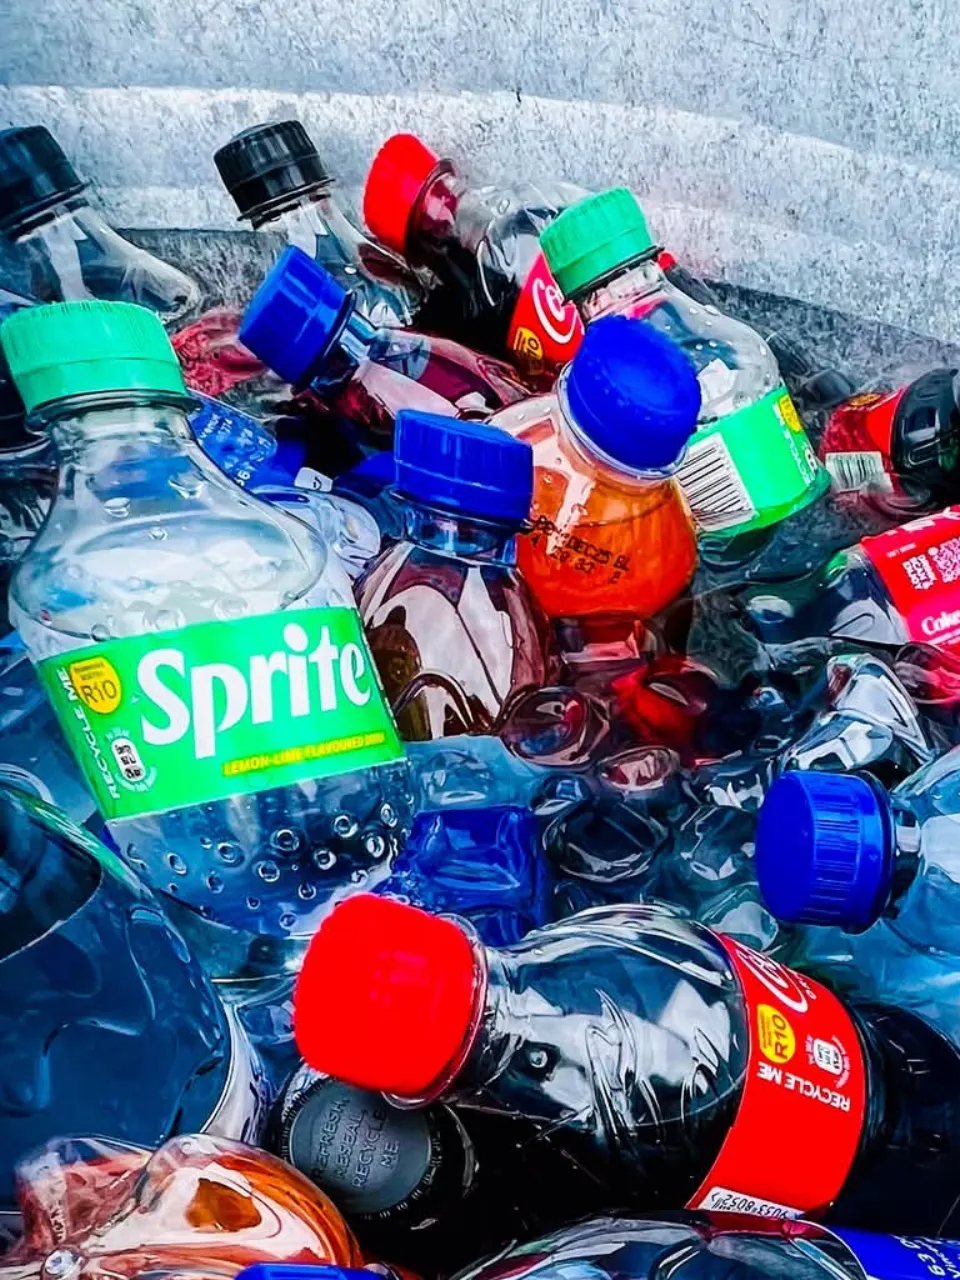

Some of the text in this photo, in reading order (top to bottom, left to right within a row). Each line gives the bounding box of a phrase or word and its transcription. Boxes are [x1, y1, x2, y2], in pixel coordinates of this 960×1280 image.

[56, 666, 79, 702] ME
[80, 679, 119, 705] R10
[137, 622, 371, 759] Sprite
[73, 704, 121, 800] RECYCLE
[771, 1013, 790, 1061] R10
[756, 1061, 851, 1112] RECYCLE ME
[334, 1108, 369, 1181] RESEAL
[352, 1108, 388, 1190] RECYCLE
[379, 1140, 400, 1169] ME
